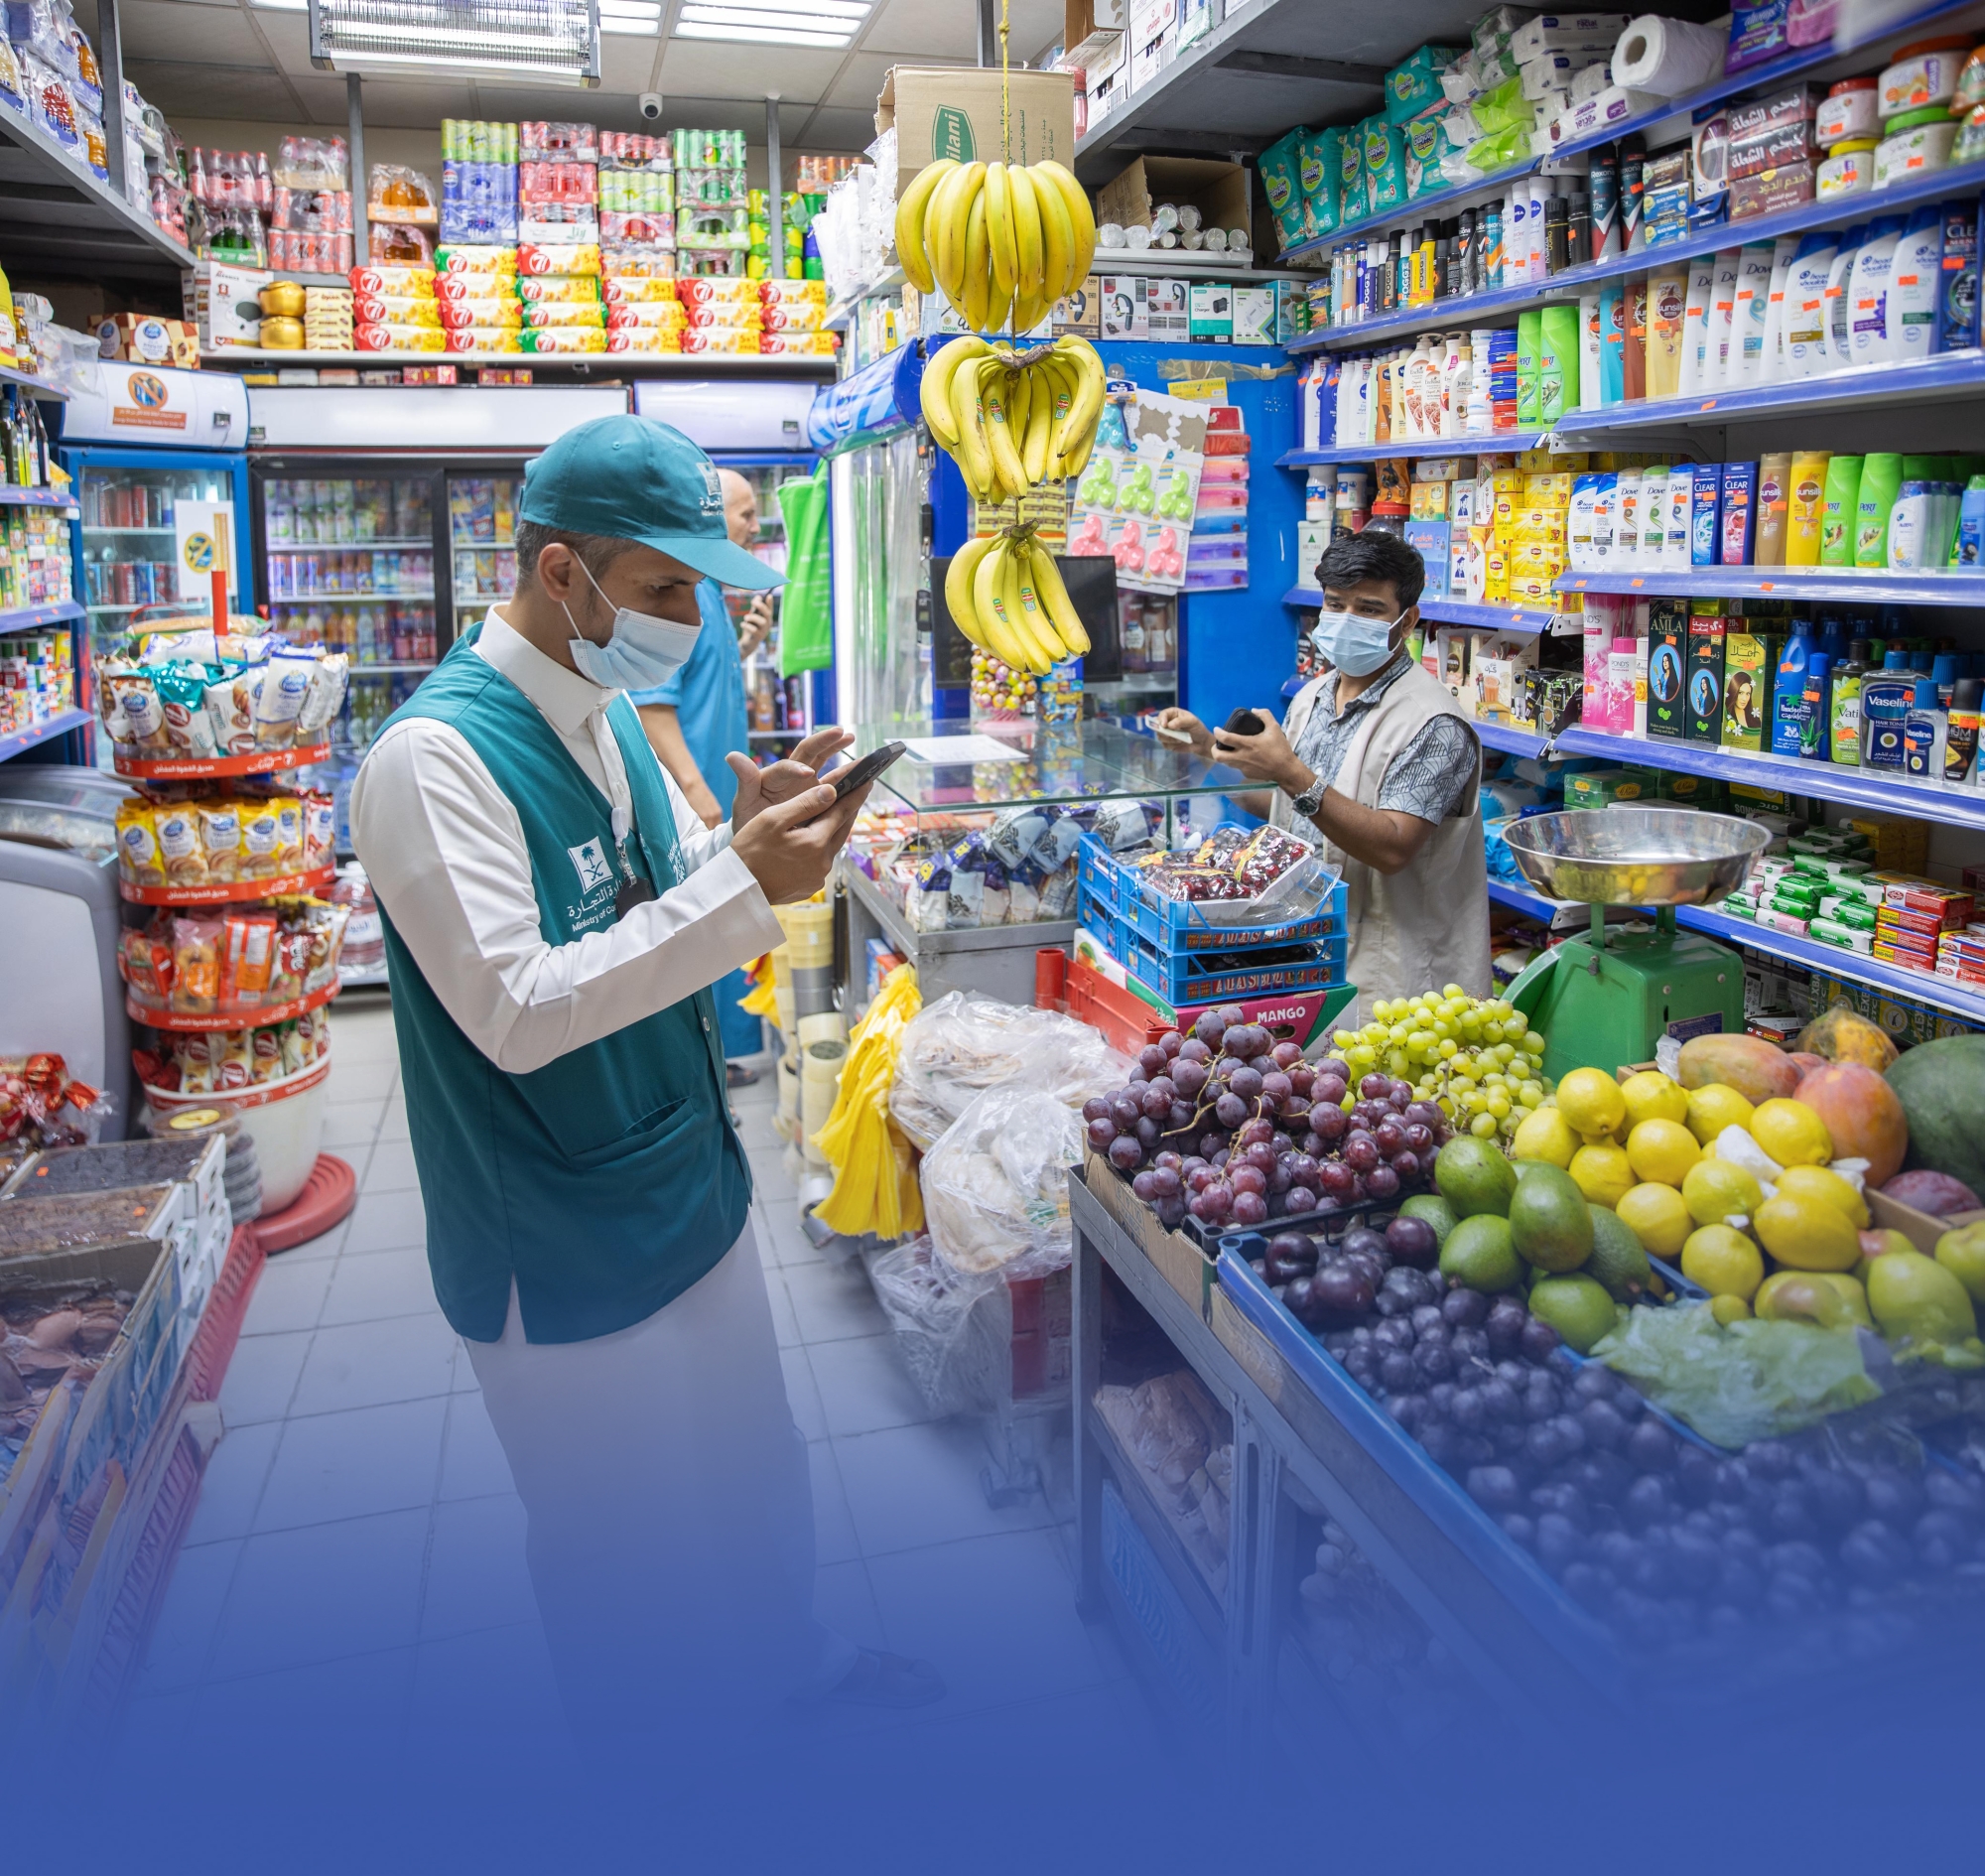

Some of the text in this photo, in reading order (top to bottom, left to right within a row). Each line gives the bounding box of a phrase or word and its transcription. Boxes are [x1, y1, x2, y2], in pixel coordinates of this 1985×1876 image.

[1576, 19, 1598, 28] Facial
[1575, 115, 1596, 129] Facial
[1732, 108, 1768, 131] الشعلة
[944, 111, 962, 163] ilani
[1732, 146, 1765, 169] الشعلة
[1591, 168, 1616, 178] Rexona
[1619, 164, 1641, 175] exona
[1389, 184, 1395, 197] 3
[1323, 213, 1331, 226] 5
[1946, 224, 1977, 239] CLE
[1746, 263, 1772, 275] Dove
[1697, 276, 1712, 287] Do
[1721, 271, 1737, 283] Do
[1657, 301, 1685, 313] sunsilk
[1670, 483, 1687, 492] Dove
[1694, 482, 1715, 491] CLEAR
[1725, 480, 1748, 489] CLEAR
[1621, 486, 1639, 495] Dove
[1648, 486, 1665, 495] Dove
[1759, 487, 1782, 496] sunsilk
[1796, 485, 1822, 496] sunsilk
[1859, 503, 1877, 512] PERT
[1659, 610, 1675, 619] Dabur
[1651, 618, 1684, 632] AMLA
[1868, 695, 1914, 708] Vaseline
[1839, 707, 1859, 719] Vati
[1906, 730, 1933, 739] Vaseline
[1759, 802, 1779, 811] GTC
[1836, 885, 1853, 895] ORIGINAL
[567, 885, 608, 919] التجارة
[1845, 911, 1863, 921] ORIGINAL
[572, 913, 598, 932] Ministry
[1820, 931, 1838, 941] ORIGINAL
[1257, 1005, 1306, 1023] MANGO
